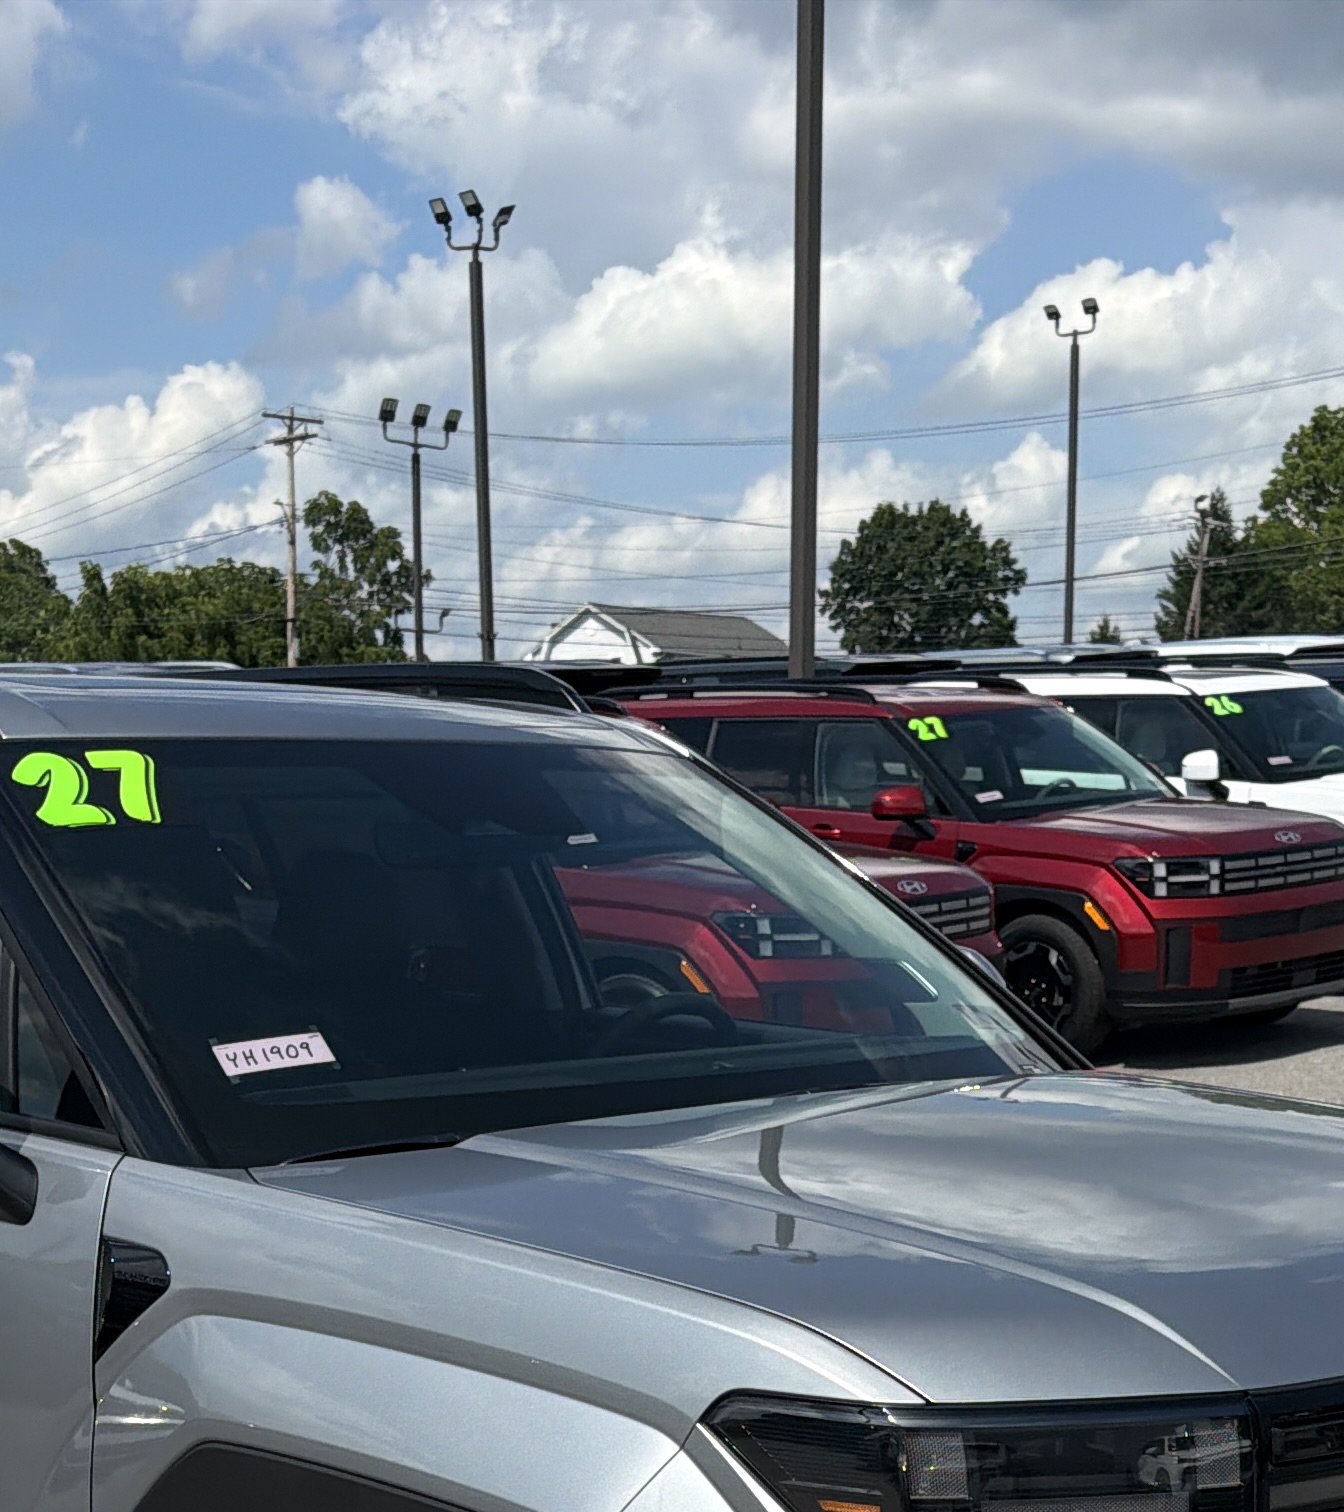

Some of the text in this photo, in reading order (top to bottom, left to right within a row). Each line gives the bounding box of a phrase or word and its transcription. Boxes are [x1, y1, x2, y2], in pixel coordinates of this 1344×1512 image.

[1204, 695, 1244, 716] 26
[907, 716, 949, 741] 27
[11, 749, 162, 828] 27
[225, 1041, 314, 1068] YH1909
